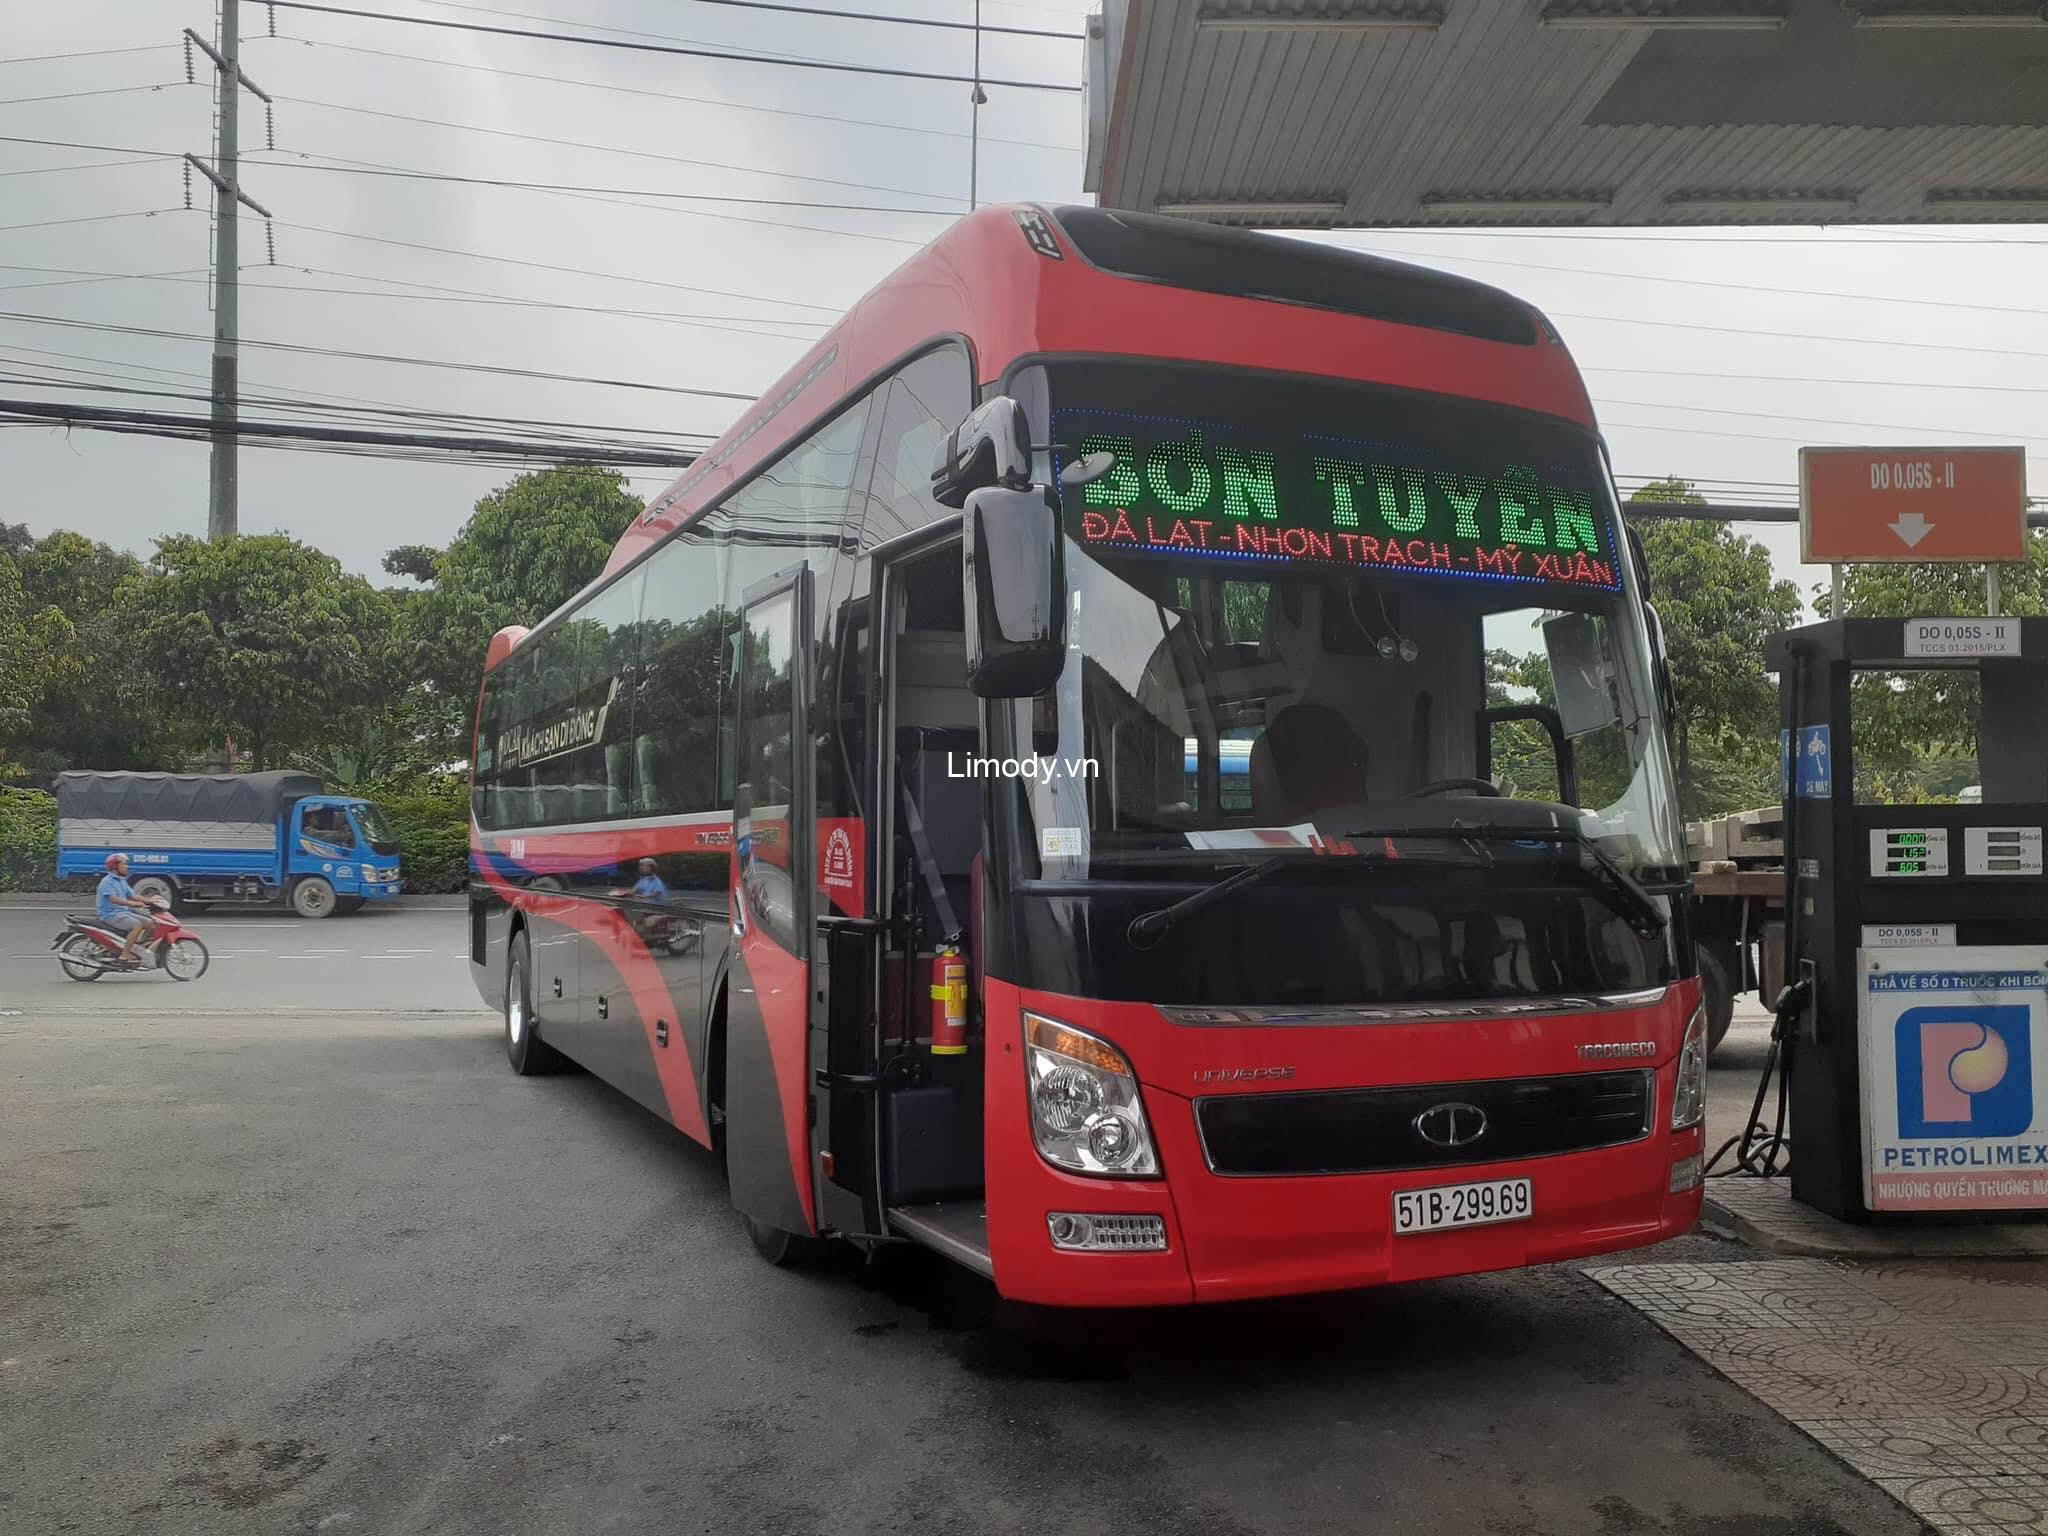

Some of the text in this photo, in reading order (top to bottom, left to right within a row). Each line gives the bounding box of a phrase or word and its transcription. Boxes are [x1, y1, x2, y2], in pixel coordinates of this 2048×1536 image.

[1871, 463, 1889, 488] DO
[1082, 508, 1137, 541] ĐÀ
[1147, 516, 1213, 547] LẠT
[1237, 524, 1332, 557] NHƠN
[1338, 533, 1451, 568] TRẠCH
[1532, 551, 1613, 585] XUÂN
[1919, 627, 1940, 639] DO
[1878, 929, 1893, 937] DO
[1921, 974, 1939, 988] SỐ
[1999, 976, 2020, 986] KHI
[1884, 1145, 2048, 1167] PETROLIMEX
[1400, 1182, 1527, 1228] 51B-299.69
